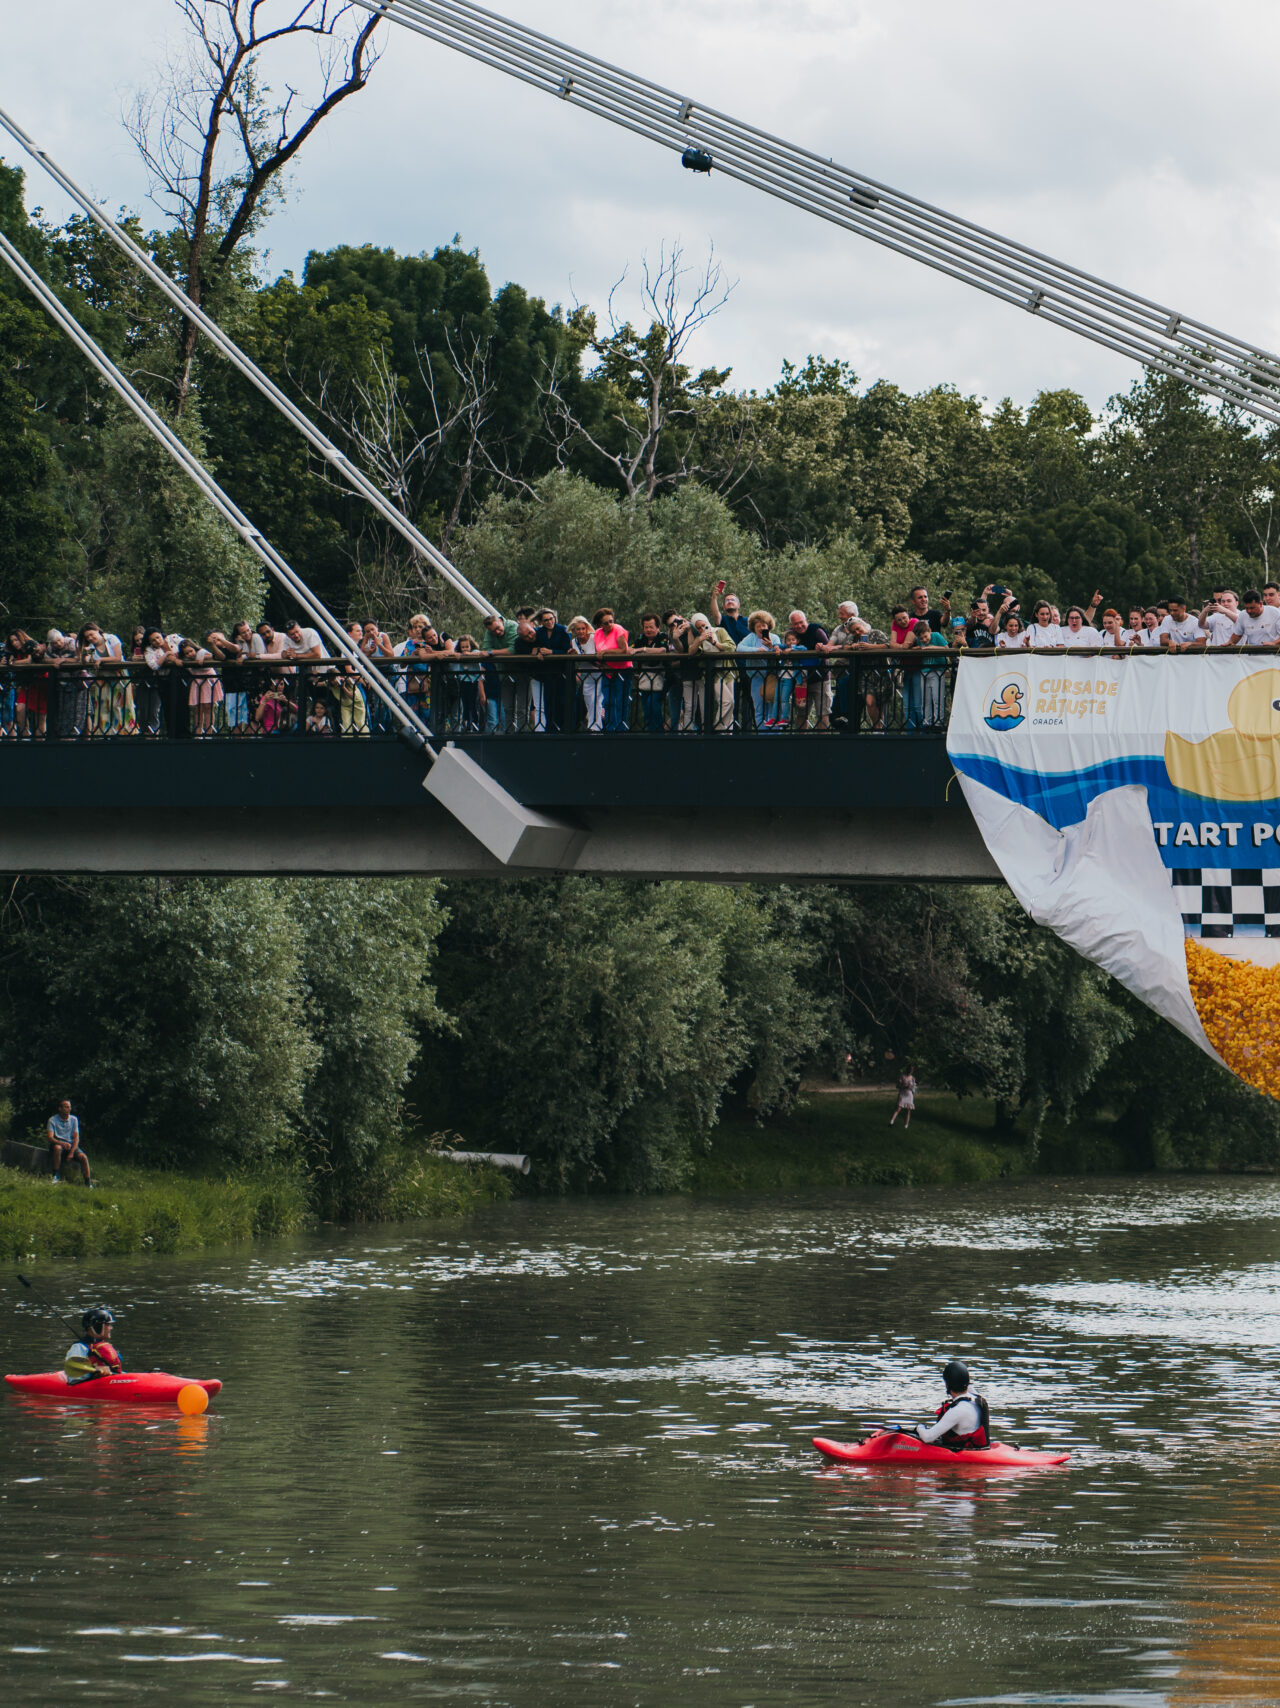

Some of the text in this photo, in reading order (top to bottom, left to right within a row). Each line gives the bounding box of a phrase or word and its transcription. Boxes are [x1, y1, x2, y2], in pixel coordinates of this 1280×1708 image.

[1039, 679, 1119, 696] CURSA DE
[1032, 718, 1064, 726] ORADEA
[1153, 822, 1244, 847] TART
